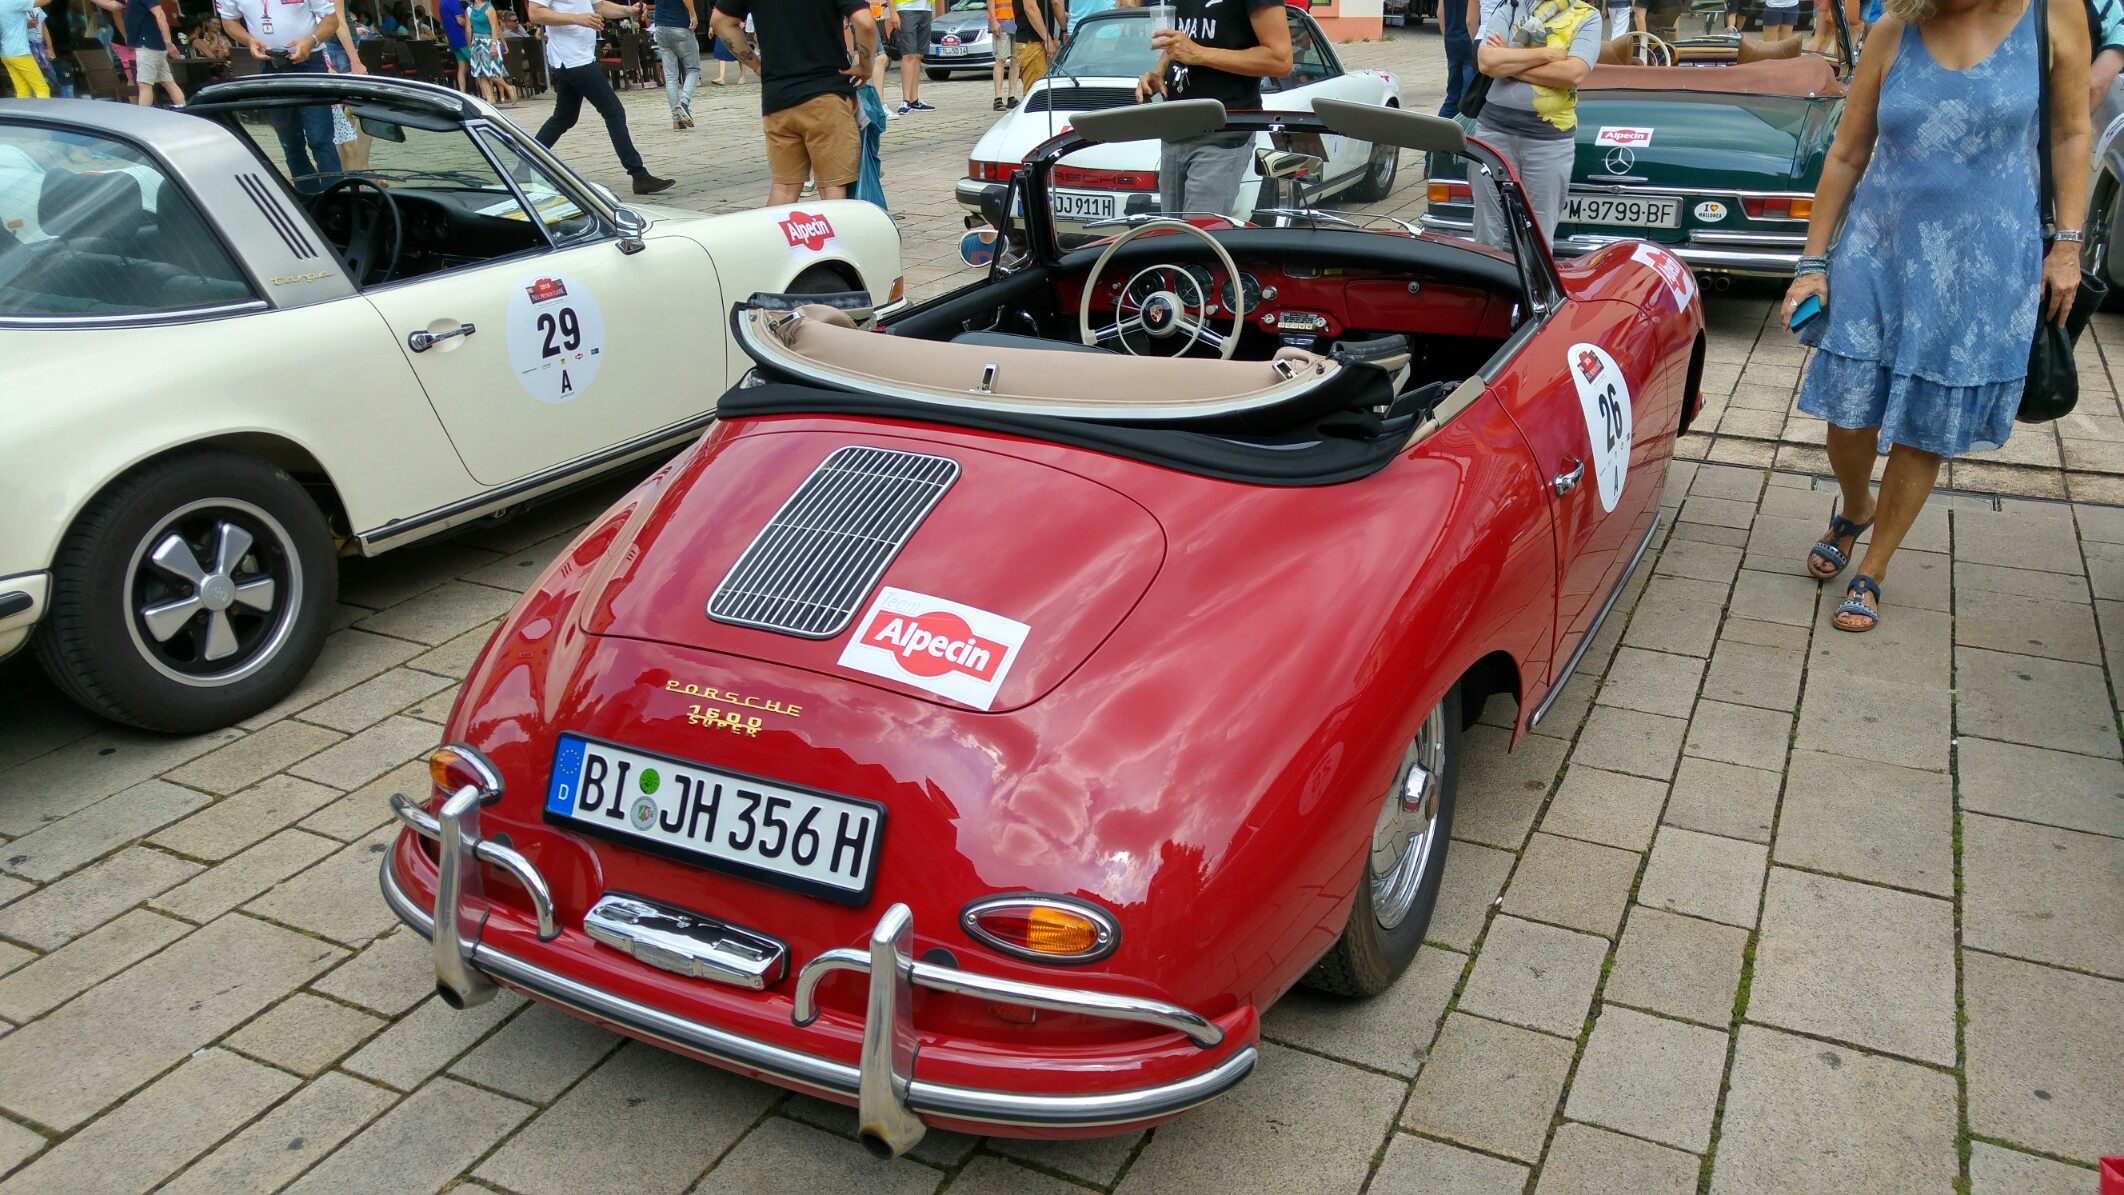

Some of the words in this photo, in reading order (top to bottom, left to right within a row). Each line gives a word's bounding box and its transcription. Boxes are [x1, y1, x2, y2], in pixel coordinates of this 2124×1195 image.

[1604, 130, 1645, 142] Alpecin
[786, 217, 830, 244] Alpecin
[537, 307, 581, 359] 29
[561, 369, 573, 394] A
[1598, 383, 1623, 455] 26
[873, 617, 991, 672] Alpecin
[665, 680, 803, 717] PORSCHE
[687, 704, 763, 731] 1600
[687, 715, 758, 738] SUPER
[557, 783, 570, 801] D
[579, 754, 631, 820] BI
[659, 774, 723, 843] JH
